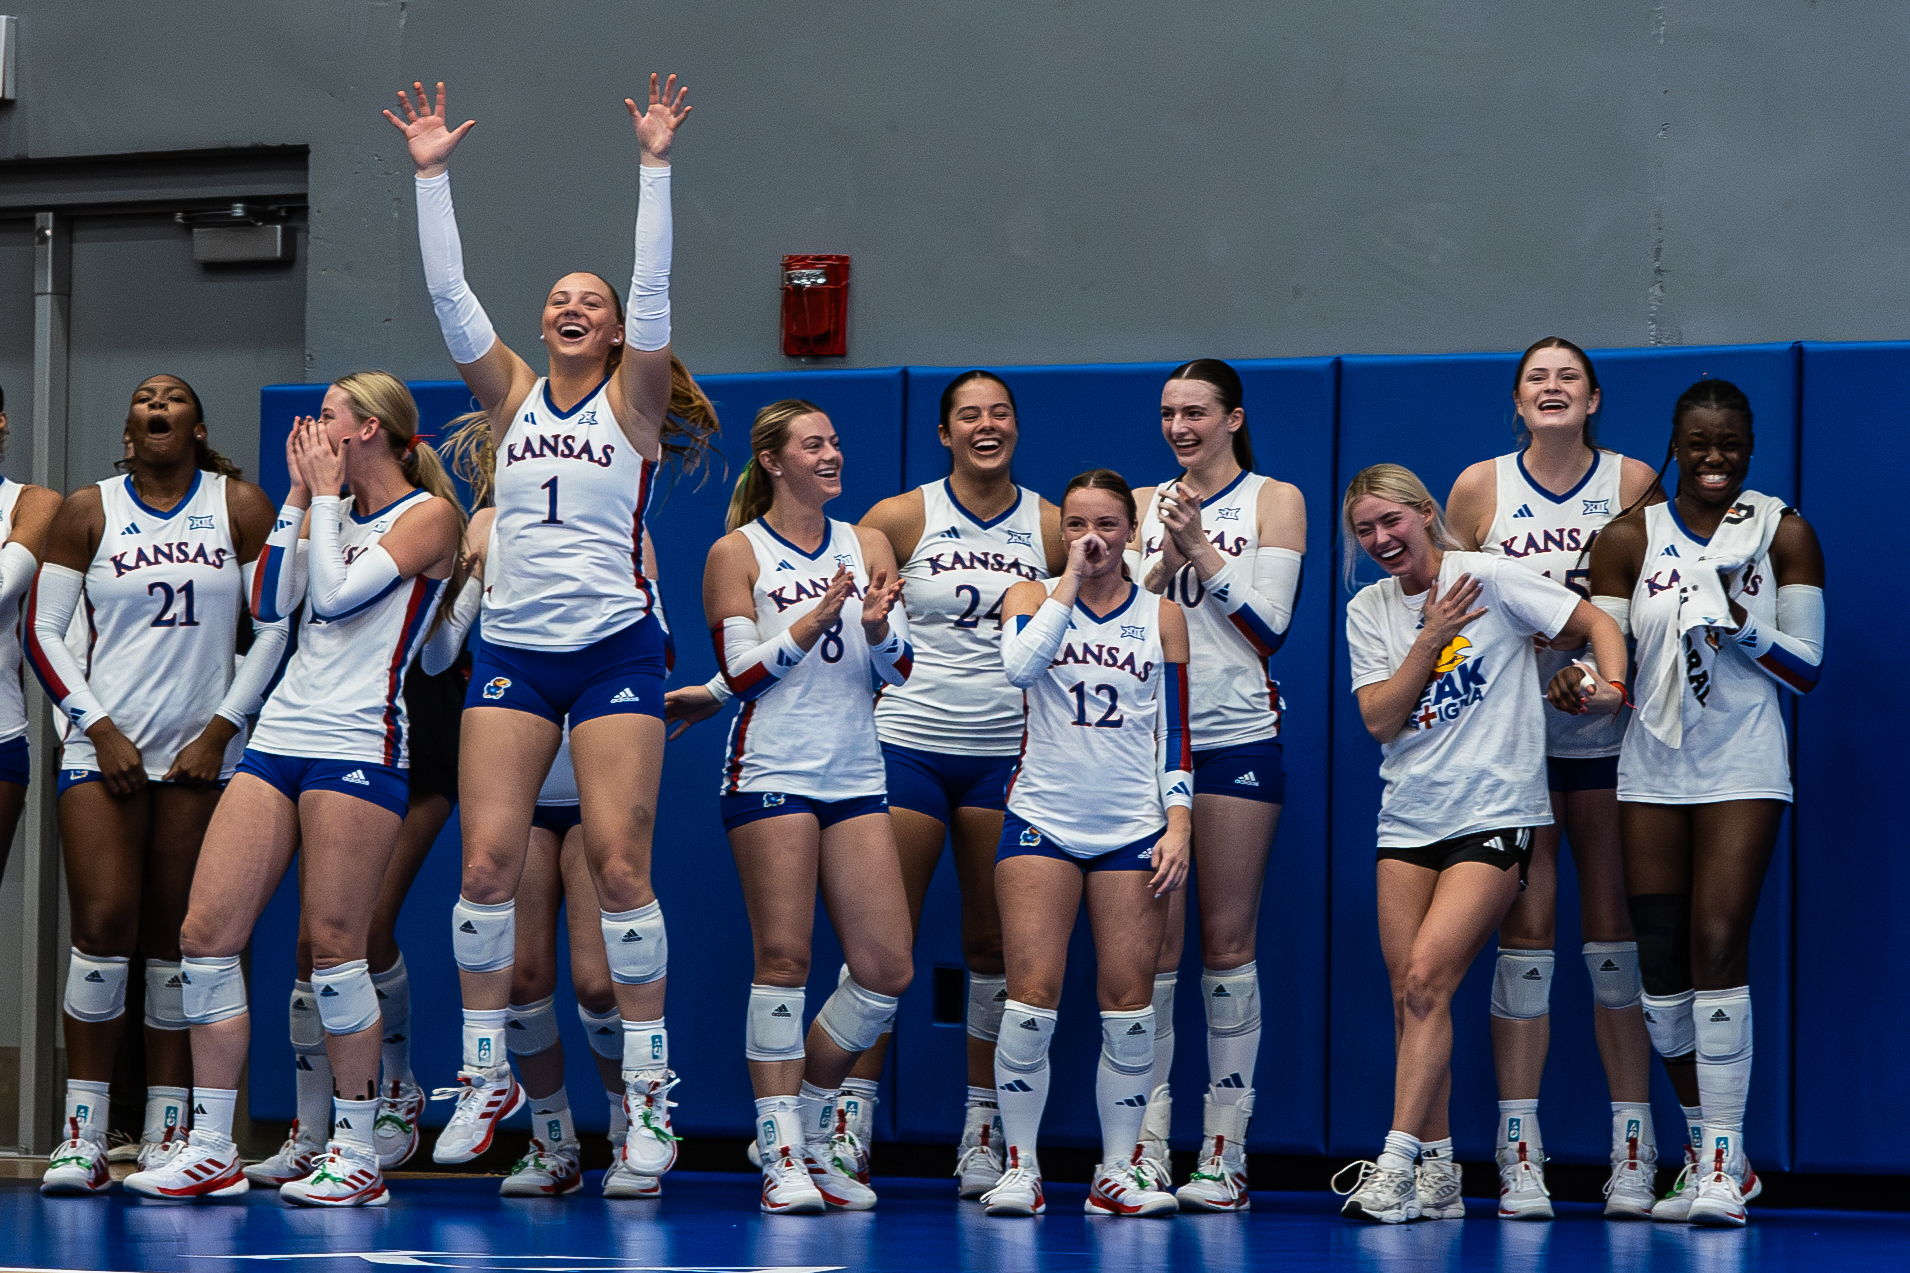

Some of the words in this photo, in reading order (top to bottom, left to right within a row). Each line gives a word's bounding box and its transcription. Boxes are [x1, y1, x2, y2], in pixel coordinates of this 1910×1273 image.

[506, 433, 616, 468] KANSAS
[541, 475, 564, 525] 1
[109, 541, 228, 579] KANSAS
[1500, 528, 1600, 559] KANS
[147, 579, 200, 628] 21
[820, 617, 845, 664] 8
[1068, 680, 1124, 729] 12
